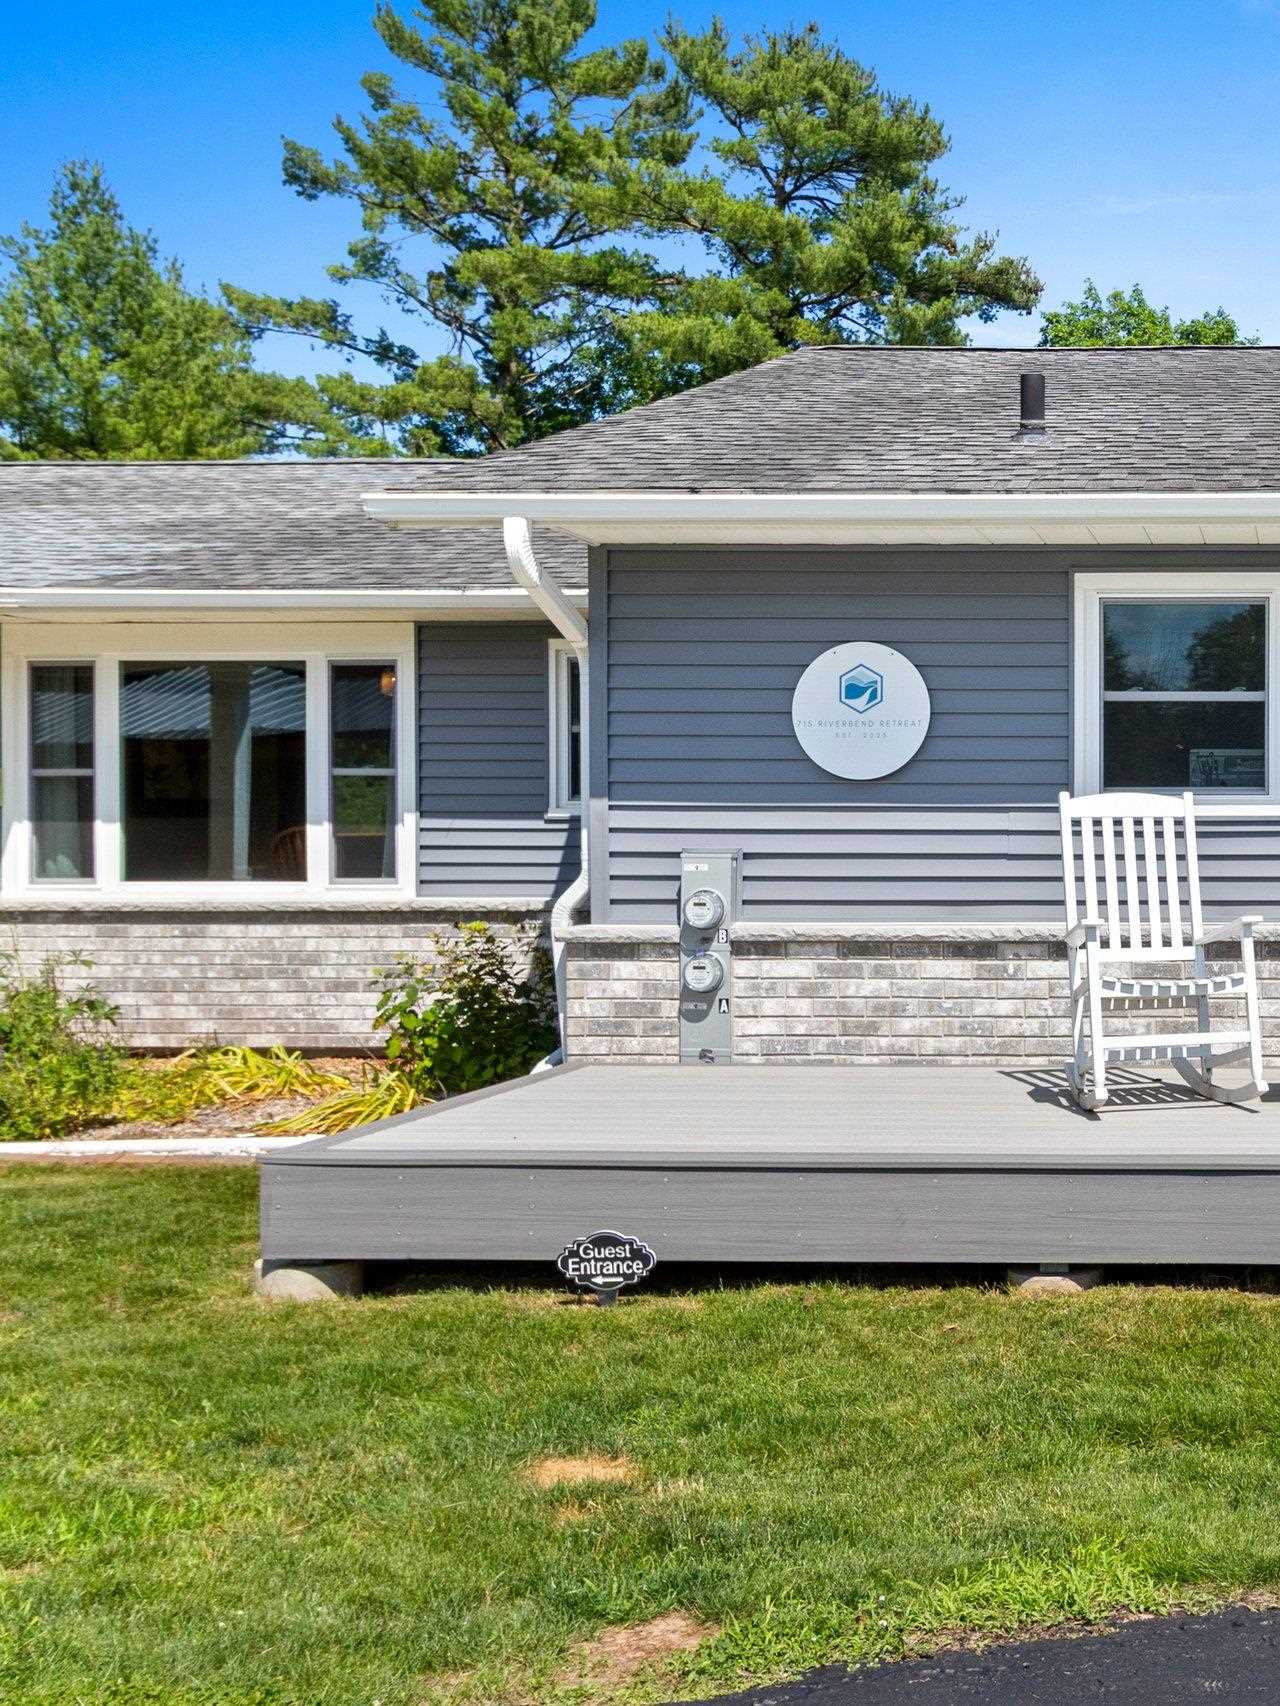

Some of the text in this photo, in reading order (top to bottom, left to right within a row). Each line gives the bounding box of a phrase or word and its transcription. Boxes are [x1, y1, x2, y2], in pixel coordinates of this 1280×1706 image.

[817, 719, 874, 728] RIVERBEND
[880, 719, 922, 728] RETREAT
[718, 929, 728, 944] B
[719, 999, 729, 1013] A
[579, 1243, 632, 1259] Guest
[568, 1258, 643, 1275] Entrance
